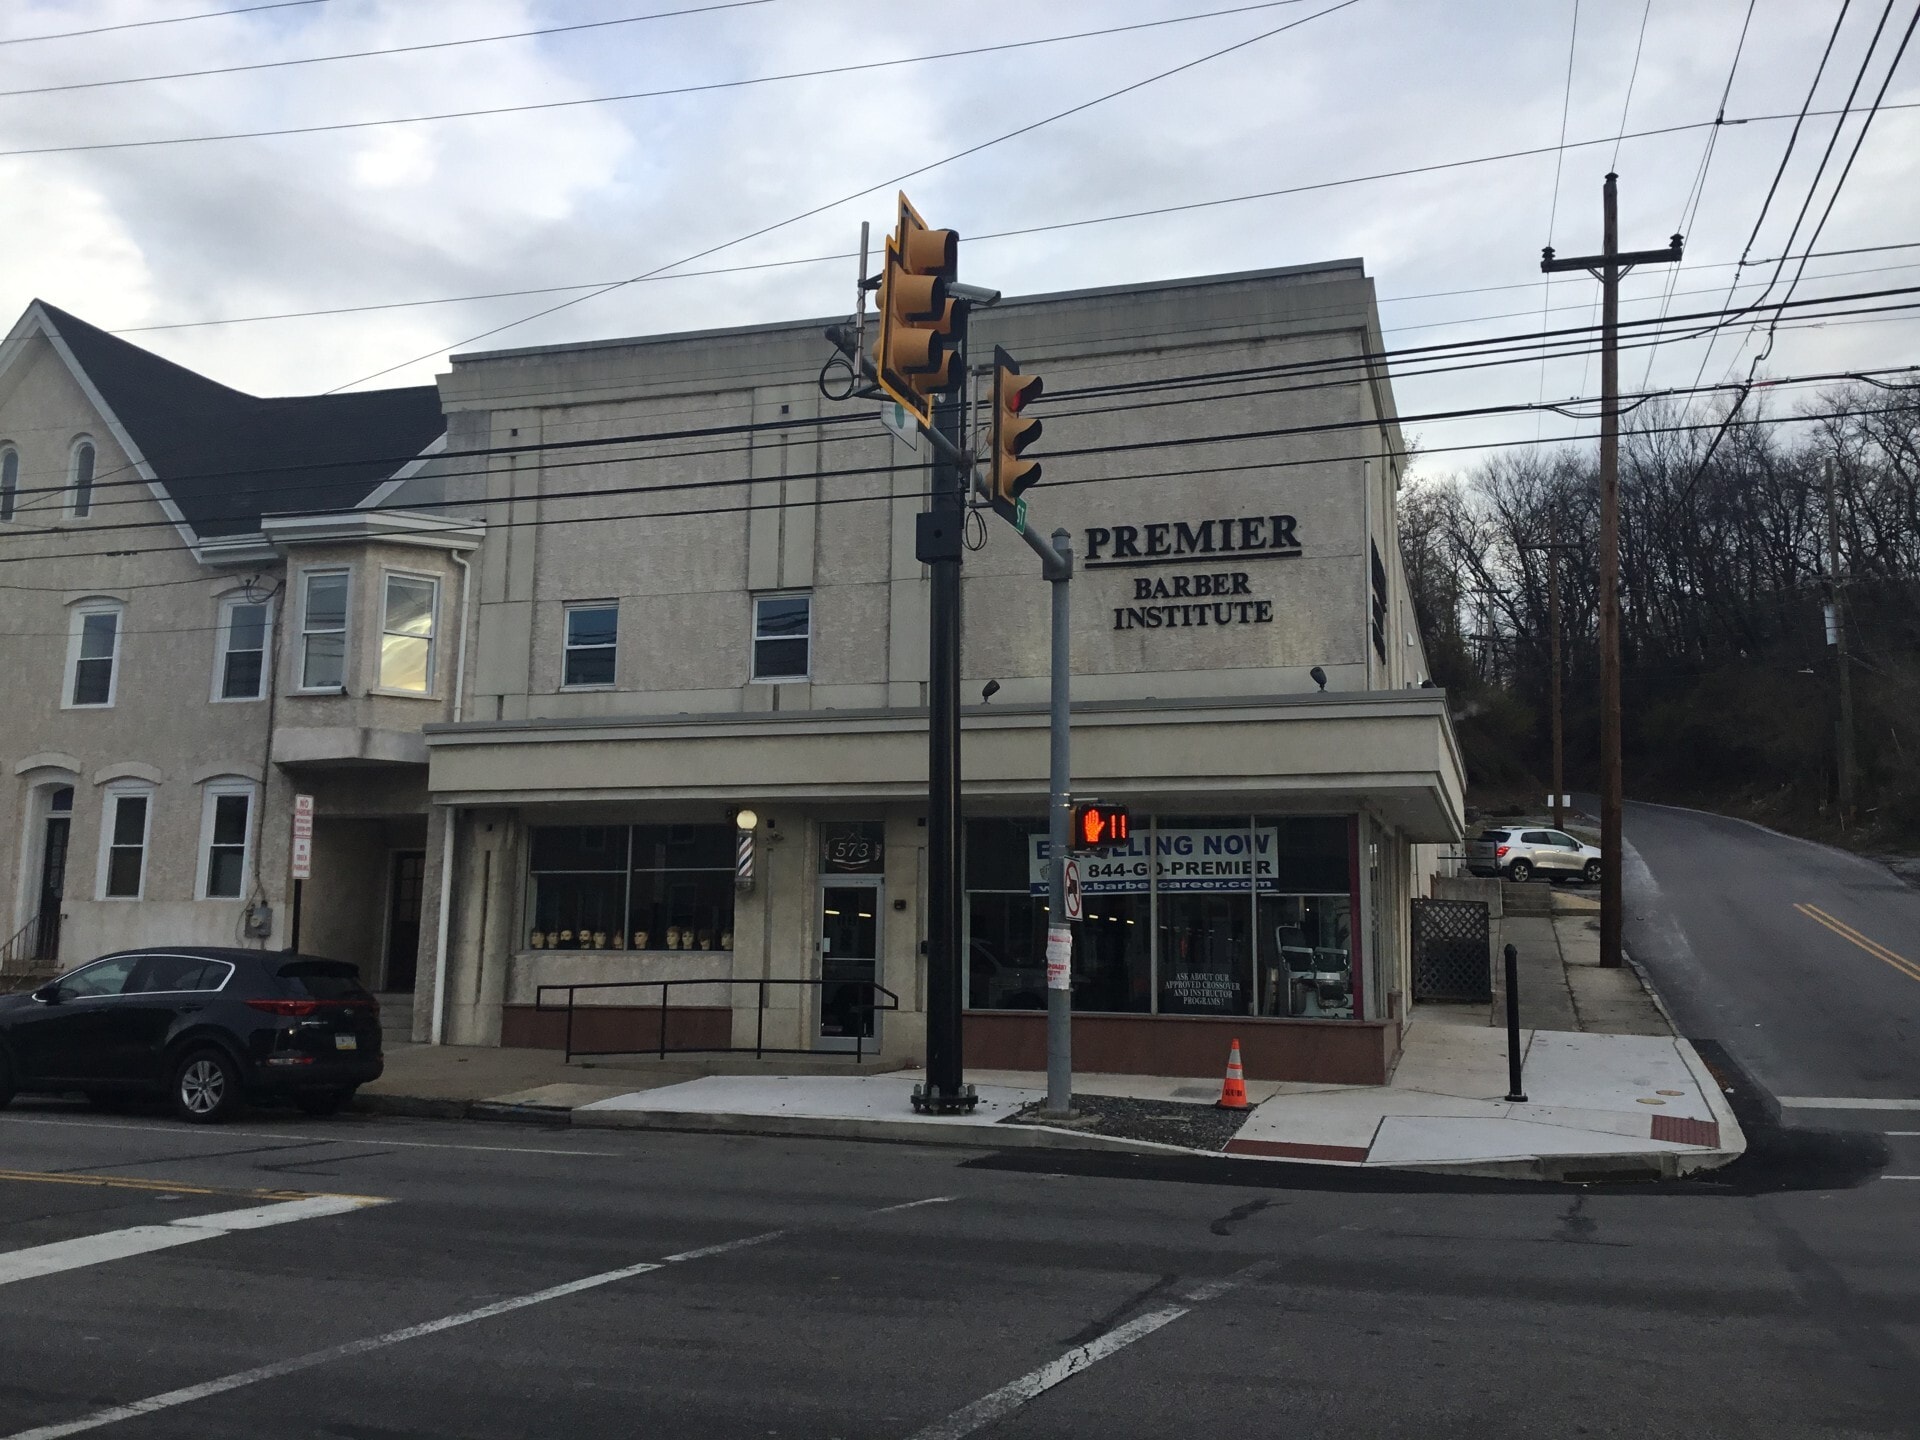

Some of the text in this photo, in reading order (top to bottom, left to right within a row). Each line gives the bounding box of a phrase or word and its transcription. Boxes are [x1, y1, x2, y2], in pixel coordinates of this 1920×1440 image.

[1084, 514, 1302, 560] PREMIER
[1133, 572, 1252, 600] BARBER
[1113, 600, 1274, 630] INSTITUTE
[299, 799, 309, 808] NO
[1110, 814, 1127, 839] 11
[835, 842, 869, 858] 573
[1203, 834, 1270, 855] NOW
[1166, 981, 1240, 990] APPROVED CROSSOVER
[1191, 973, 1213, 981] ABOUT
[1174, 989, 1232, 998] AND INSTRUCTOR
